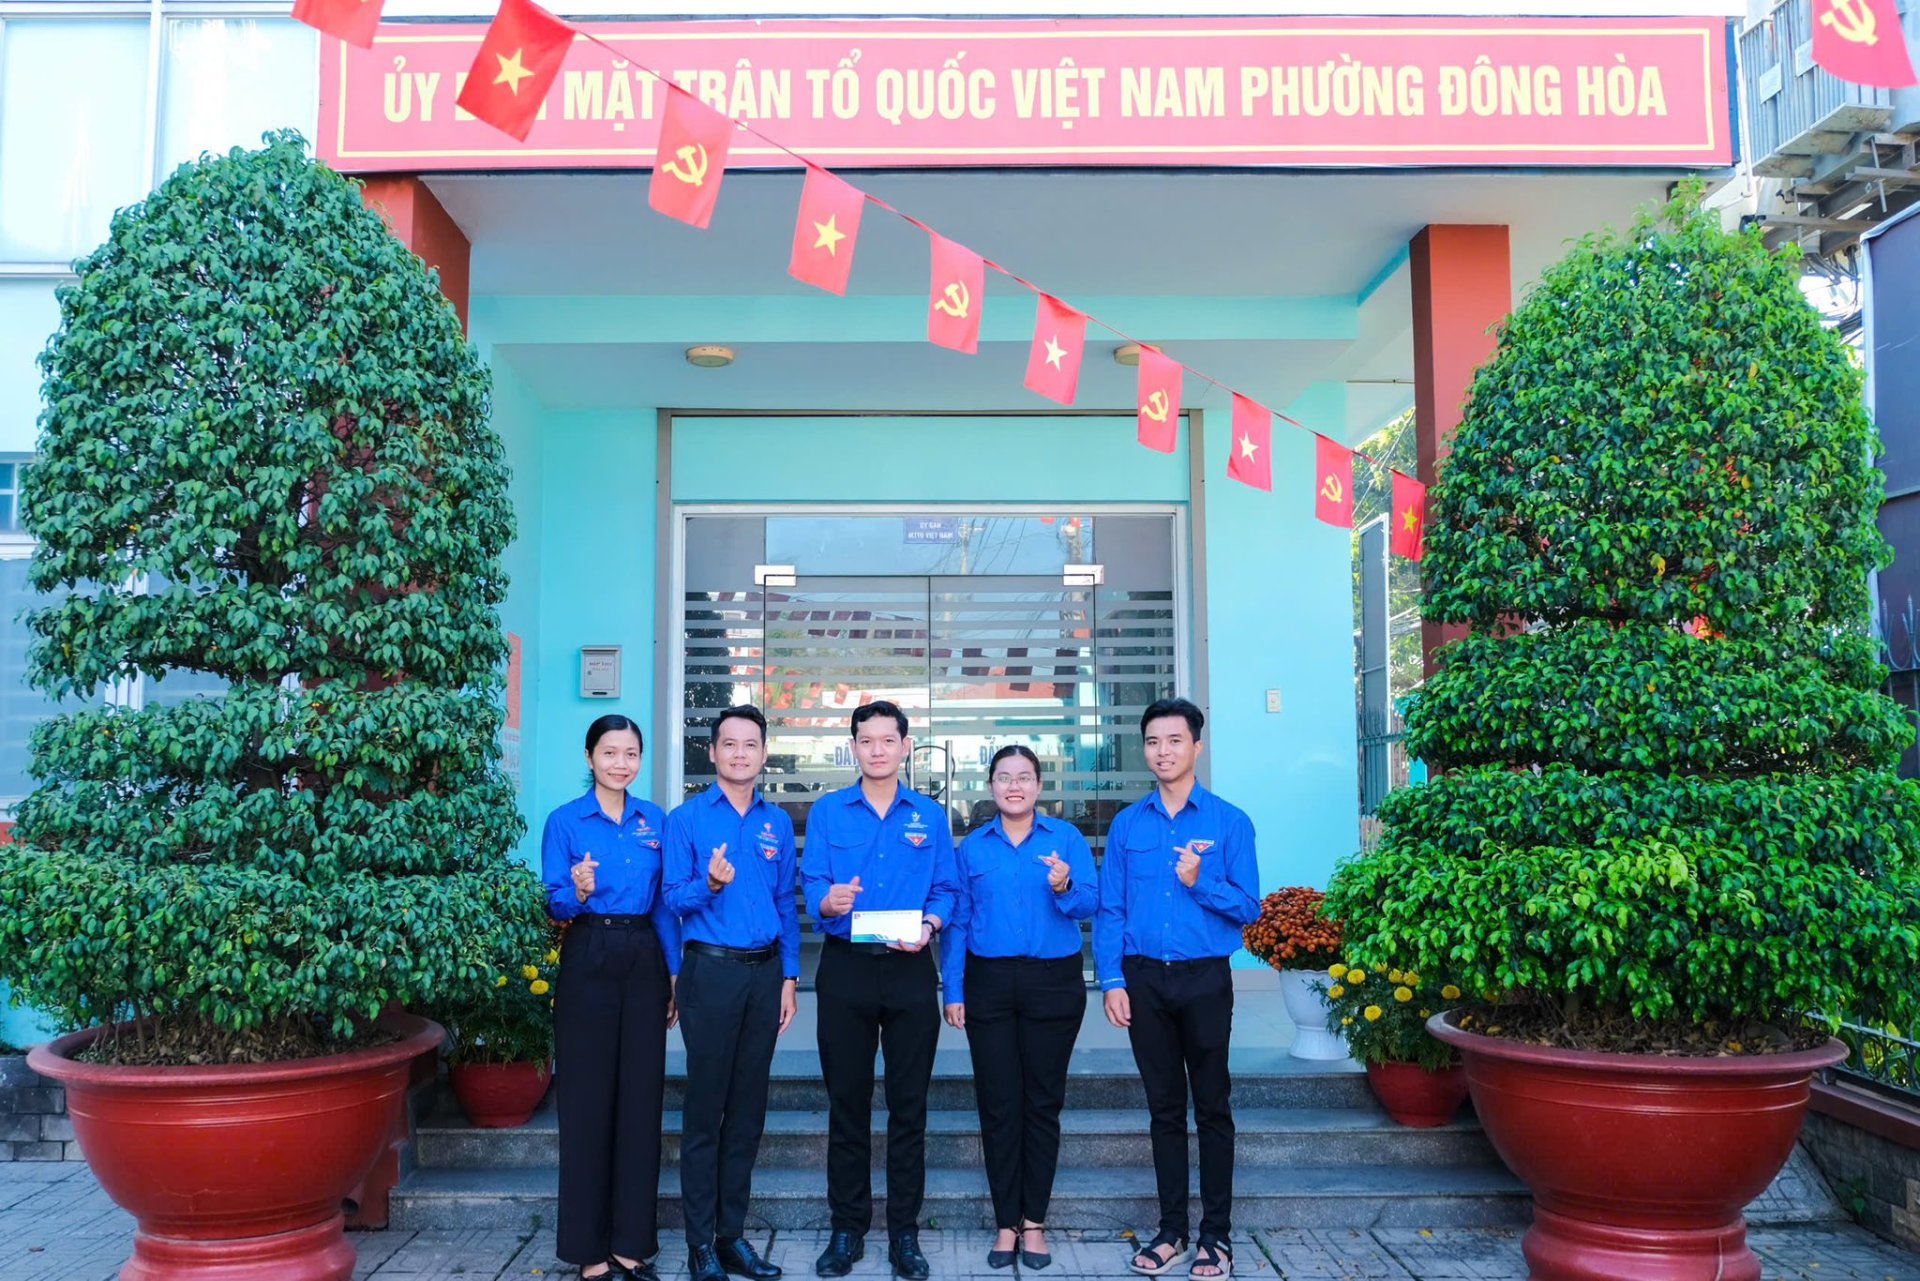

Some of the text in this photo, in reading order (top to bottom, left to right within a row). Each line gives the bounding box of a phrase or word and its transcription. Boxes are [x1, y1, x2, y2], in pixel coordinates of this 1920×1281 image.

[383, 55, 441, 123] ỦY
[563, 59, 660, 132] MẶT
[805, 48, 863, 120] TỔ
[876, 50, 996, 125] QUỐC
[1010, 56, 1106, 130] VIỆT
[1120, 66, 1226, 118] NAM
[1240, 52, 1425, 118] PHƯỜNG
[1438, 54, 1563, 117] ĐÔNG
[1576, 52, 1668, 117] HÒA
